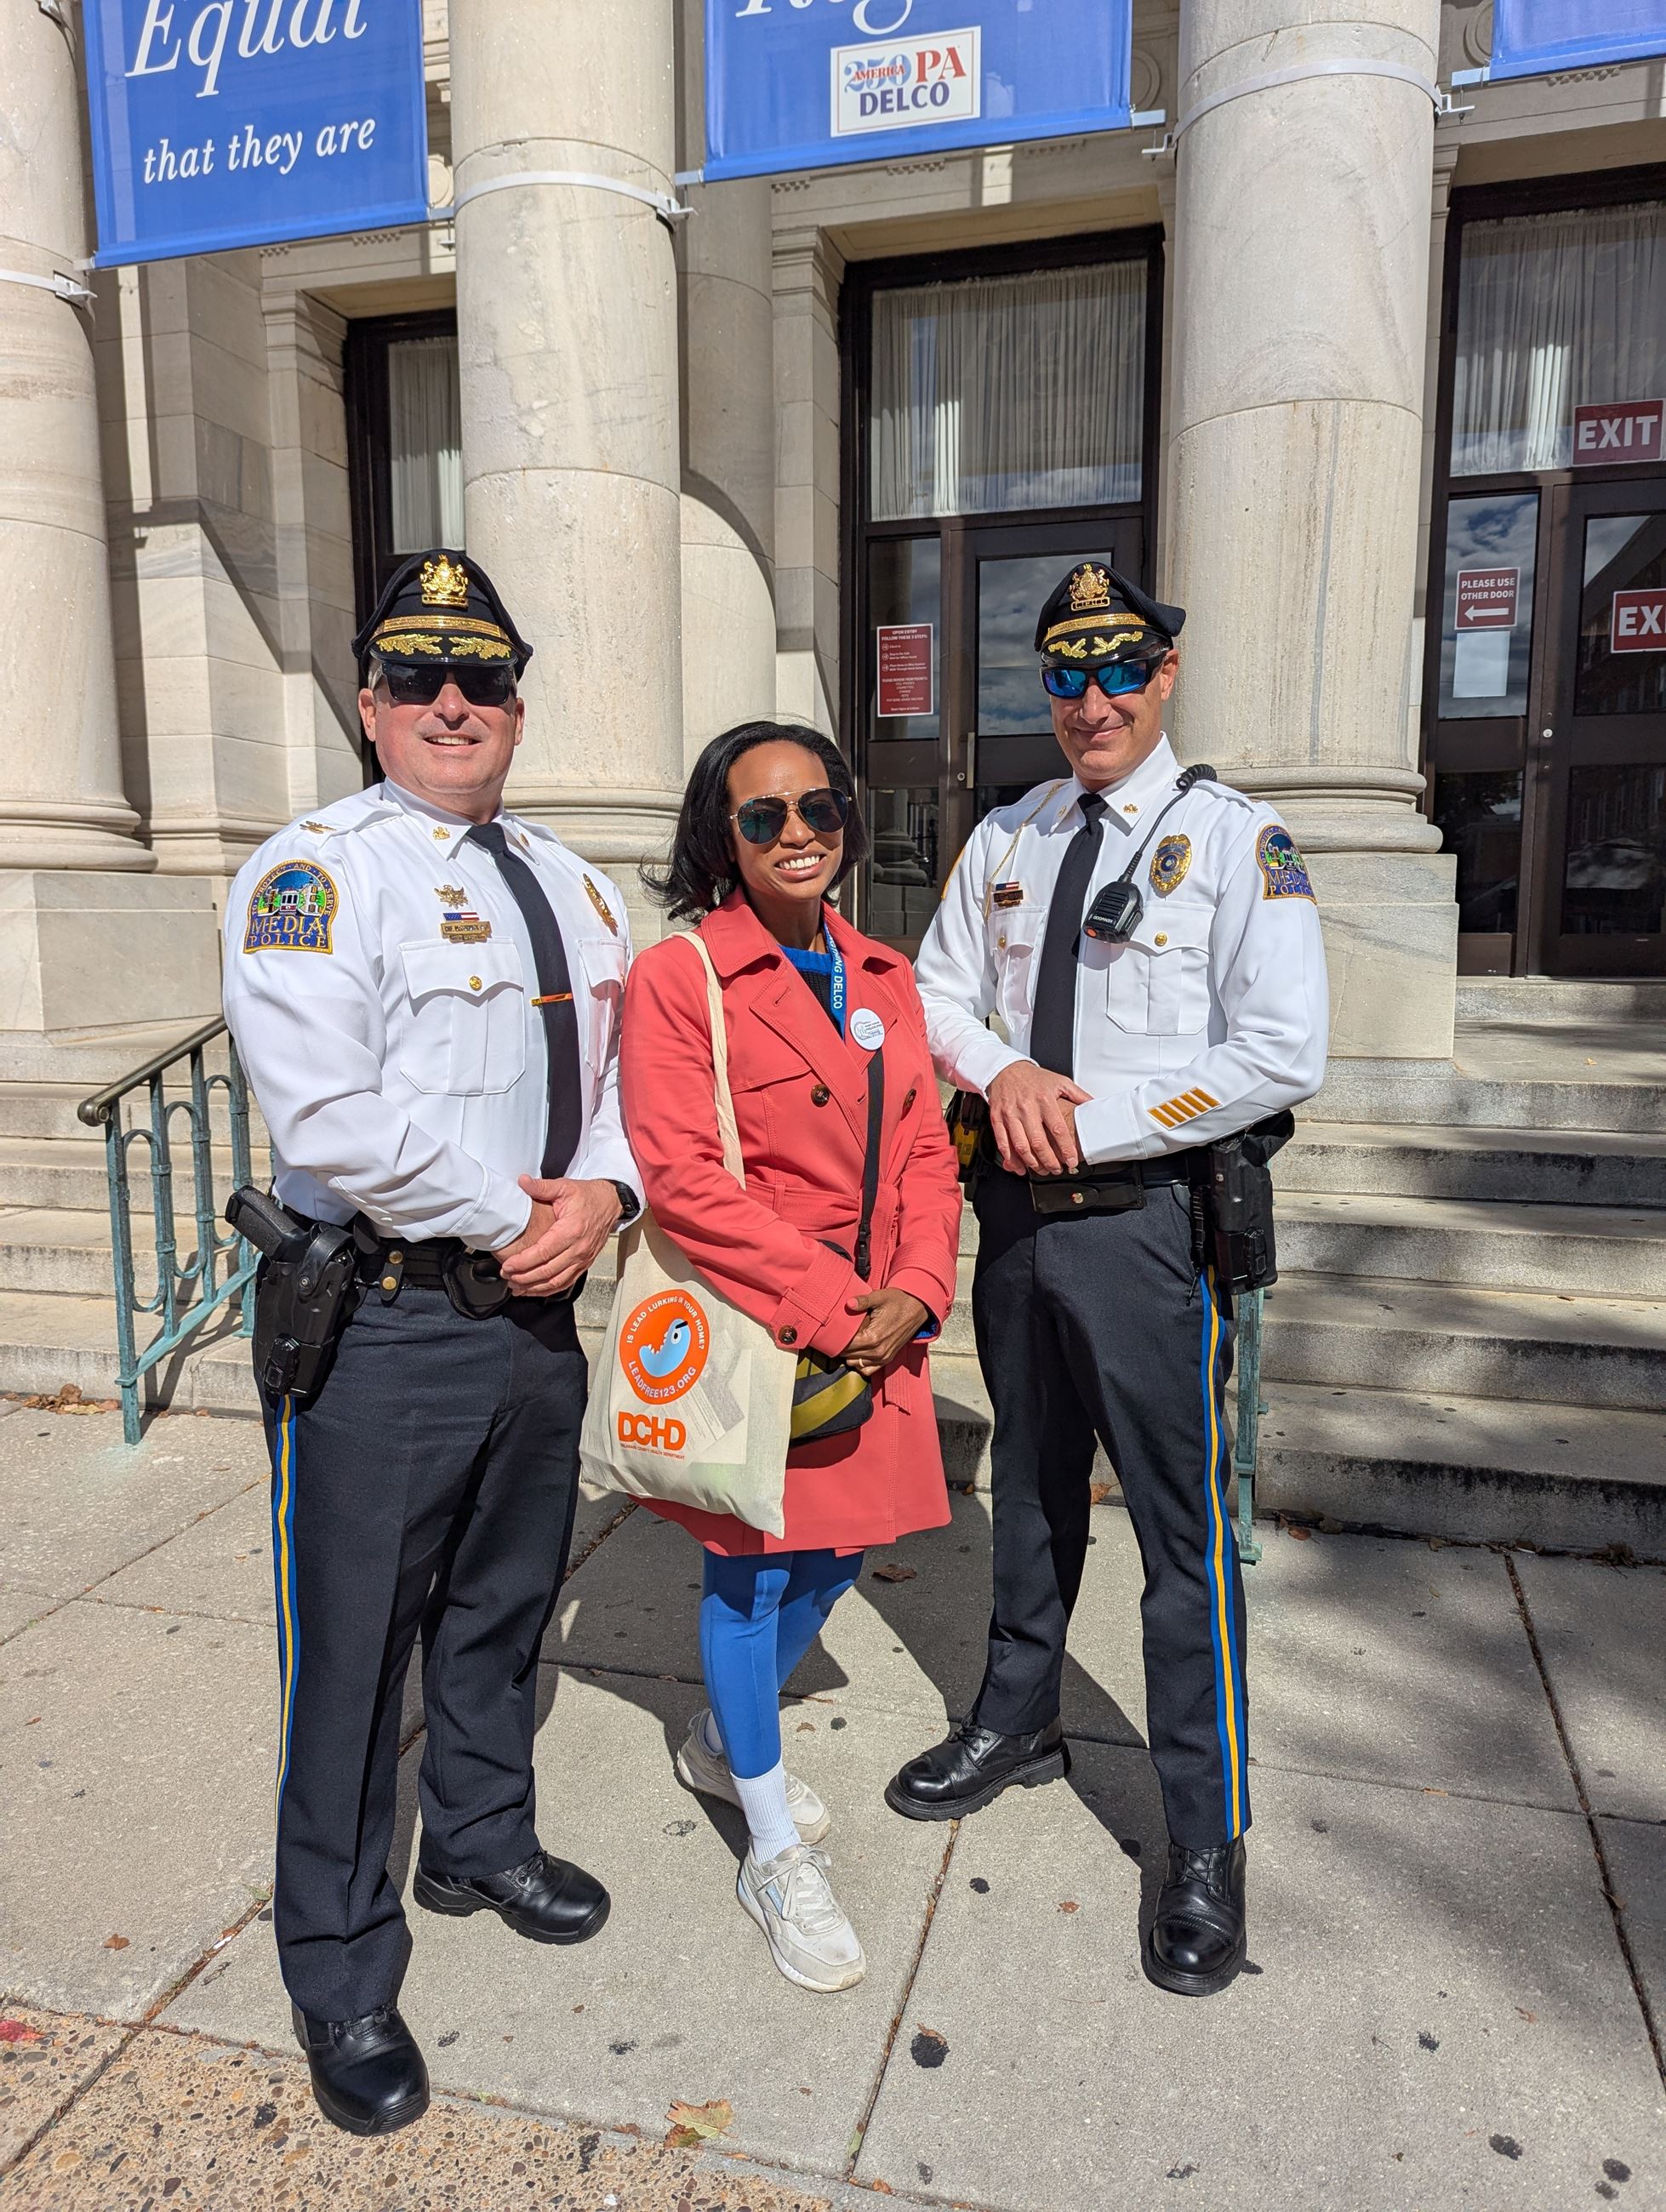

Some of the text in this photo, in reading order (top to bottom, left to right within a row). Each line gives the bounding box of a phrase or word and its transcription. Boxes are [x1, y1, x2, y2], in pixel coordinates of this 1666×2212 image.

[844, 47, 967, 93] 250 PA
[853, 64, 905, 82] AMERICA
[860, 82, 950, 117] DELCO
[143, 118, 376, 184] that they are
[1578, 414, 1658, 450] EXIT
[1461, 577, 1515, 589] PLEASE USE
[1461, 590, 1515, 601] OTHER DOOR
[1618, 604, 1666, 636] EX
[293, 863, 311, 871] AND
[317, 872, 326, 883] TO
[323, 887, 334, 915] SERVE
[248, 933, 327, 948] POLICE
[252, 915, 325, 936] MEDIA
[833, 976, 843, 1009] DELCO
[626, 1334, 634, 1343] IS
[630, 1311, 647, 1332] LEAD
[648, 1296, 677, 1313] LURKING
[683, 1300, 698, 1319] YOUR
[695, 1319, 705, 1349] HOME?
[629, 1360, 697, 1398] LEADFREE123.ORG
[617, 1411, 687, 1451] DCHD
